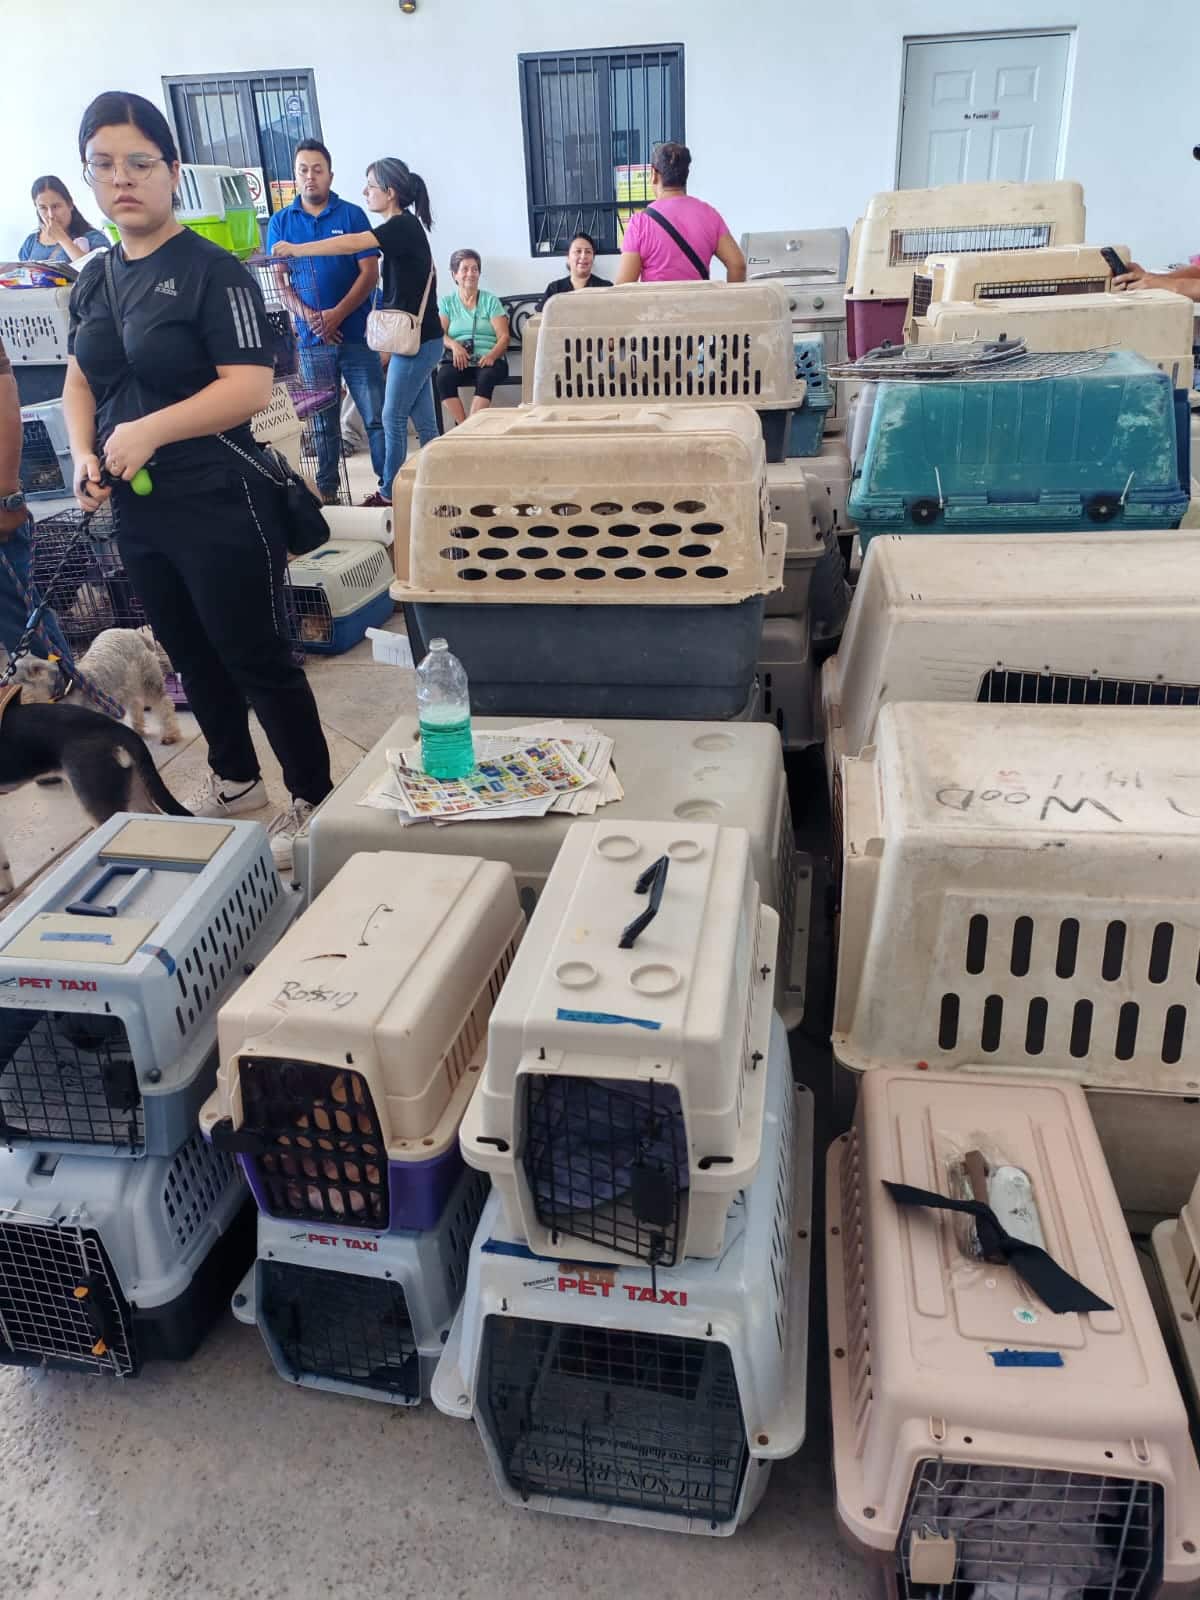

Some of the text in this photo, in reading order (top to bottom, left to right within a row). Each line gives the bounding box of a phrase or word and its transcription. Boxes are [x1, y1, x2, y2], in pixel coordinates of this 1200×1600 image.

[18, 976, 98, 992] PET TAXI
[308, 1233, 339, 1246] PET
[342, 1237, 378, 1252] TAXI
[558, 1277, 688, 1307] PET TAXI
